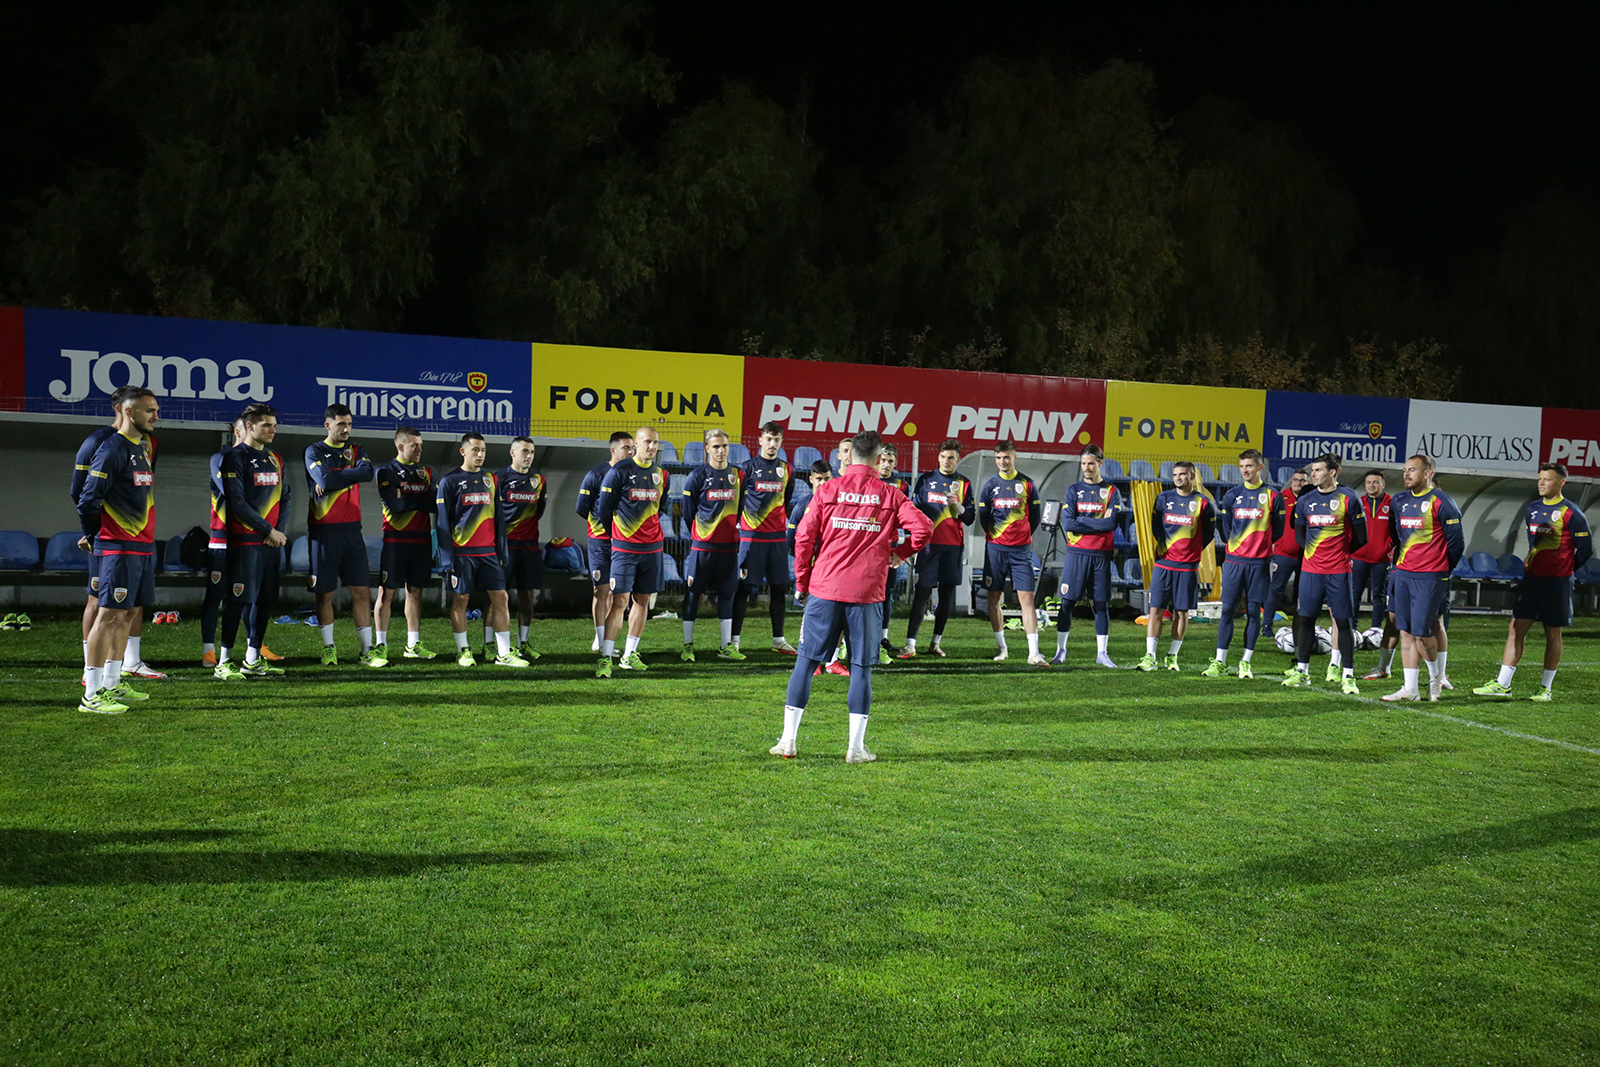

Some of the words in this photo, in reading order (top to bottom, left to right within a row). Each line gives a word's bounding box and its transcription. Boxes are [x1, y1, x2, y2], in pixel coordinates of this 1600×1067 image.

[419, 371, 439, 381] Din
[440, 371, 464, 383] 1718
[550, 386, 725, 417] FORTUNA
[1118, 416, 1250, 443] FORTUNA
[1415, 433, 1534, 462] AUTOKLASS
